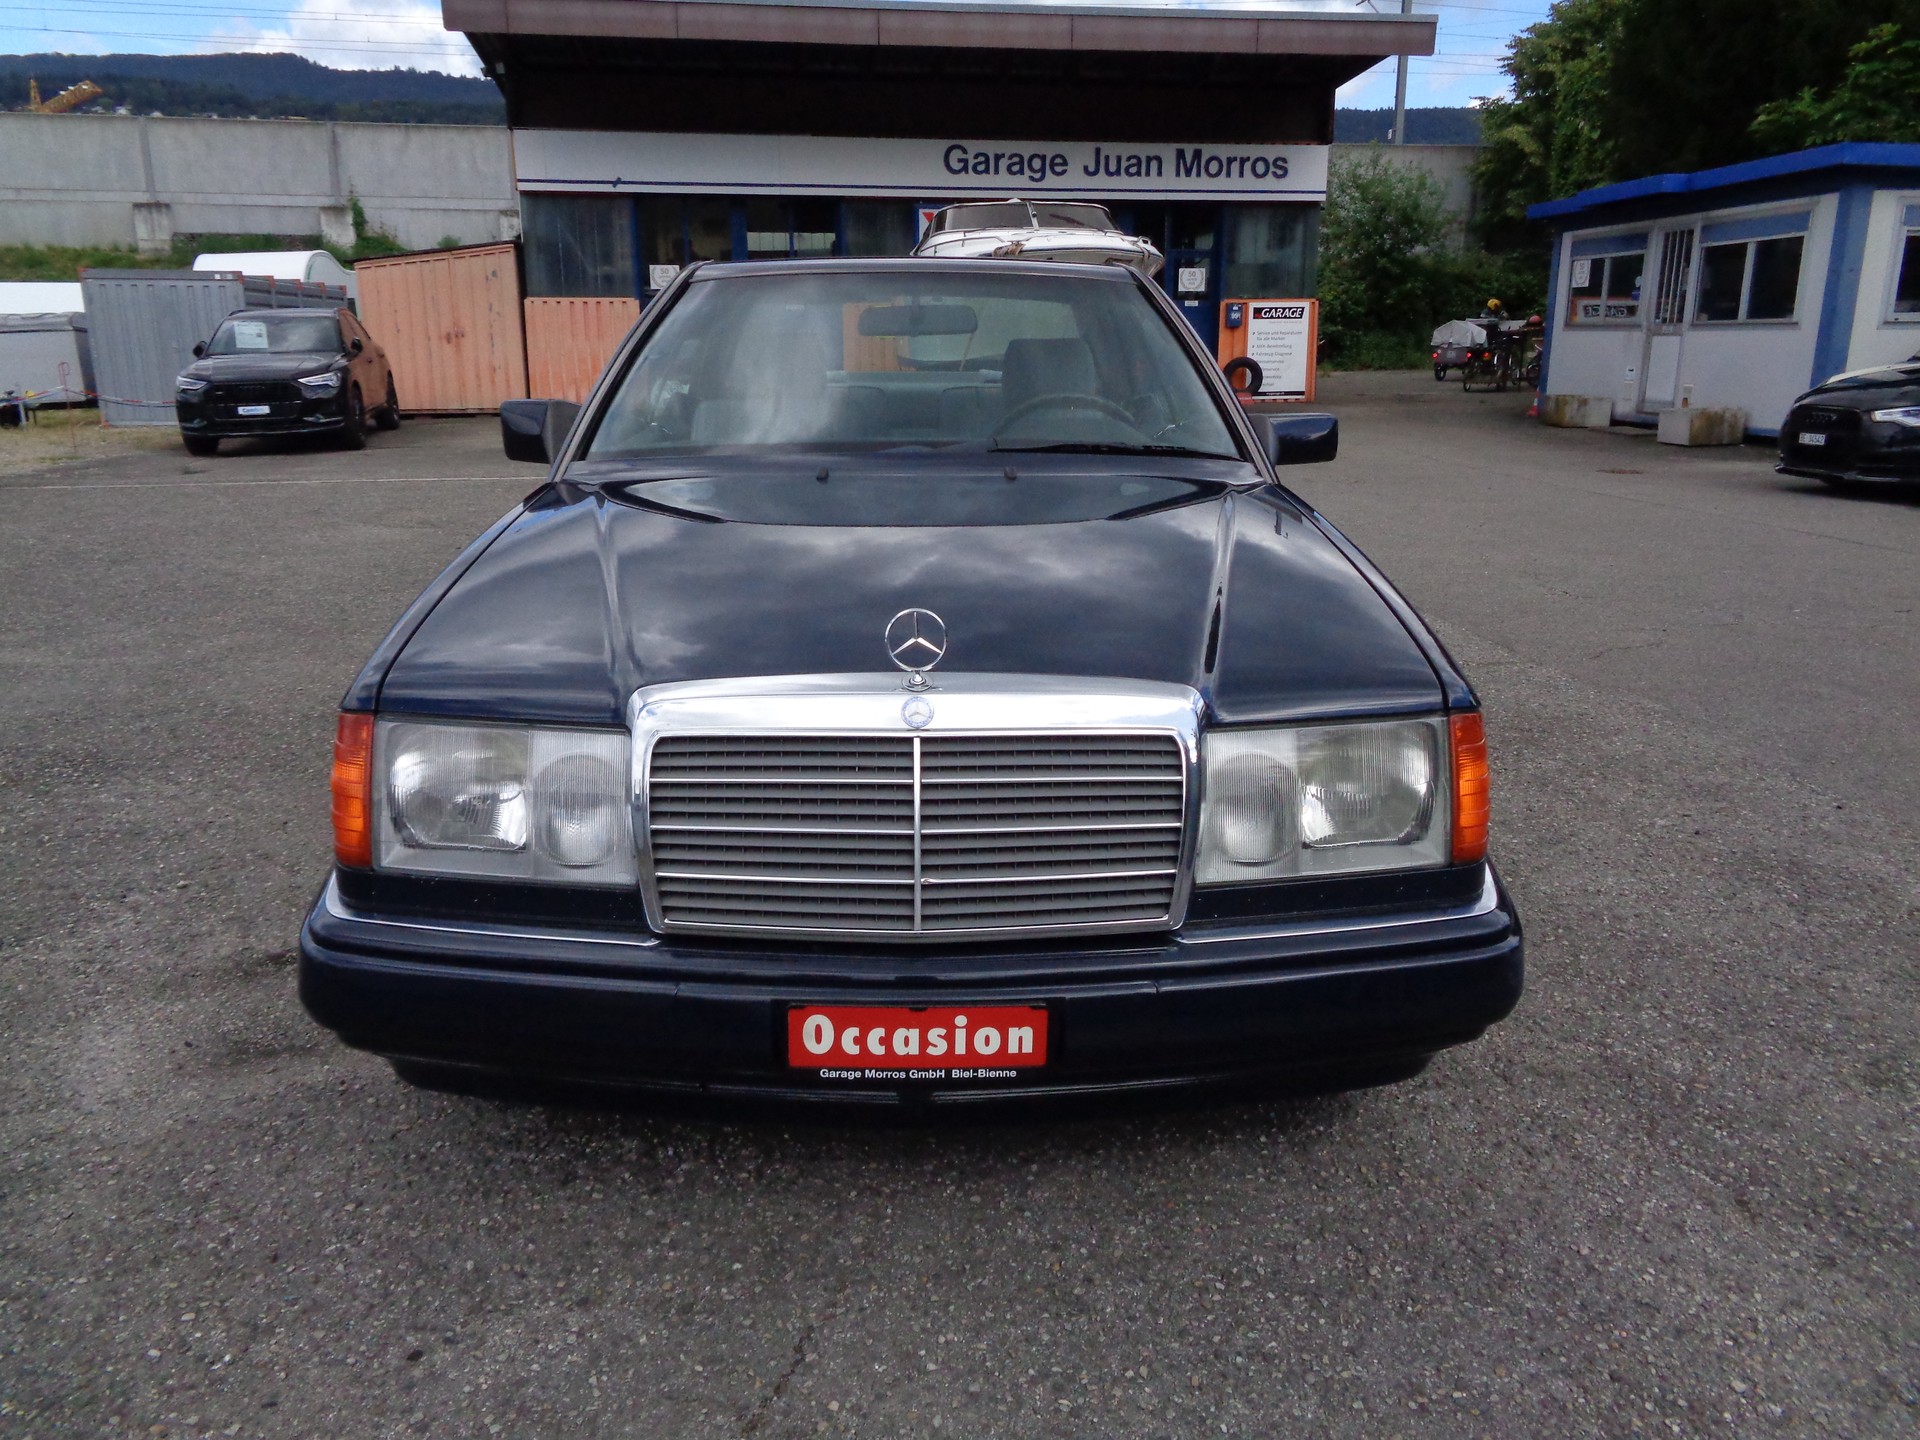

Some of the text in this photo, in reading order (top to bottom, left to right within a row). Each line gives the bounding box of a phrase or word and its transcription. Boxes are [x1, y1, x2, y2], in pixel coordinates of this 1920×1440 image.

[943, 144, 1289, 183] Garage Juan Morros
[802, 1014, 1034, 1056] Occasion
[820, 1068, 1017, 1080] Garage Morros GmbH Biel-Bienne
